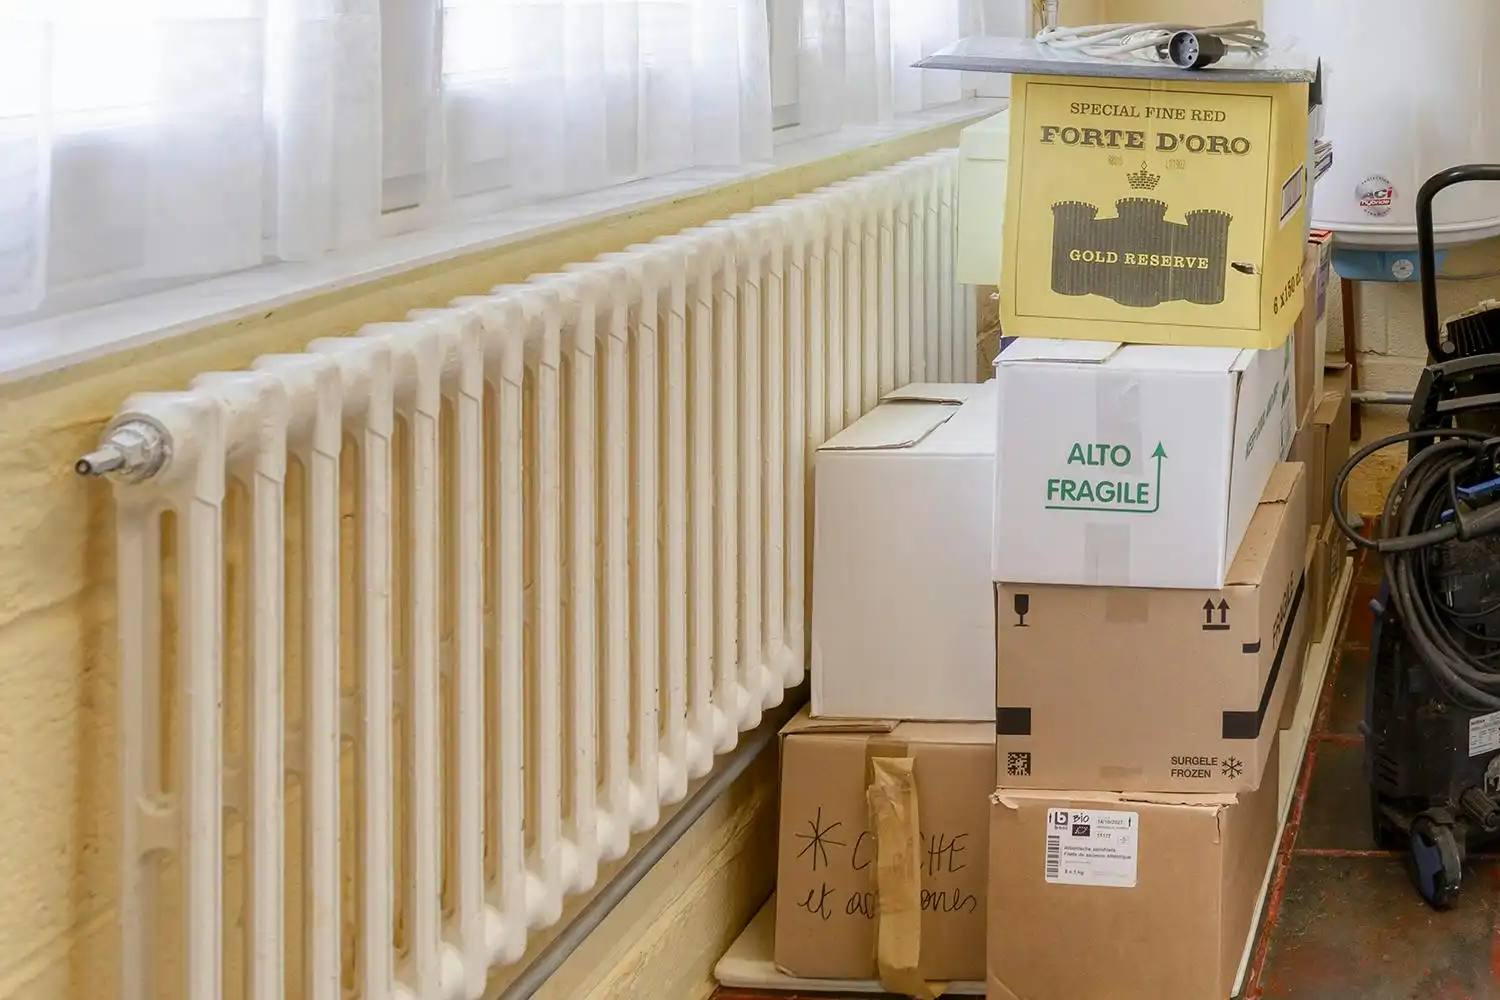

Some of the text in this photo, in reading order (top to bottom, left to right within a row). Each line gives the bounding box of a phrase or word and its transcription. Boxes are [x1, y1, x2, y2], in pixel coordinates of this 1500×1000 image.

[1070, 102, 1226, 123] SPECIAL FINE RED
[1040, 125, 1252, 155] FORTE D'ORO
[1069, 249, 1209, 270] GOLD RESERVE
[1067, 442, 1132, 468] ALTO
[1047, 478, 1150, 504] FRAGILE
[1170, 755, 1218, 766] SURGELE
[1170, 768, 1212, 778] FROZEN
[797, 882, 836, 921] et
